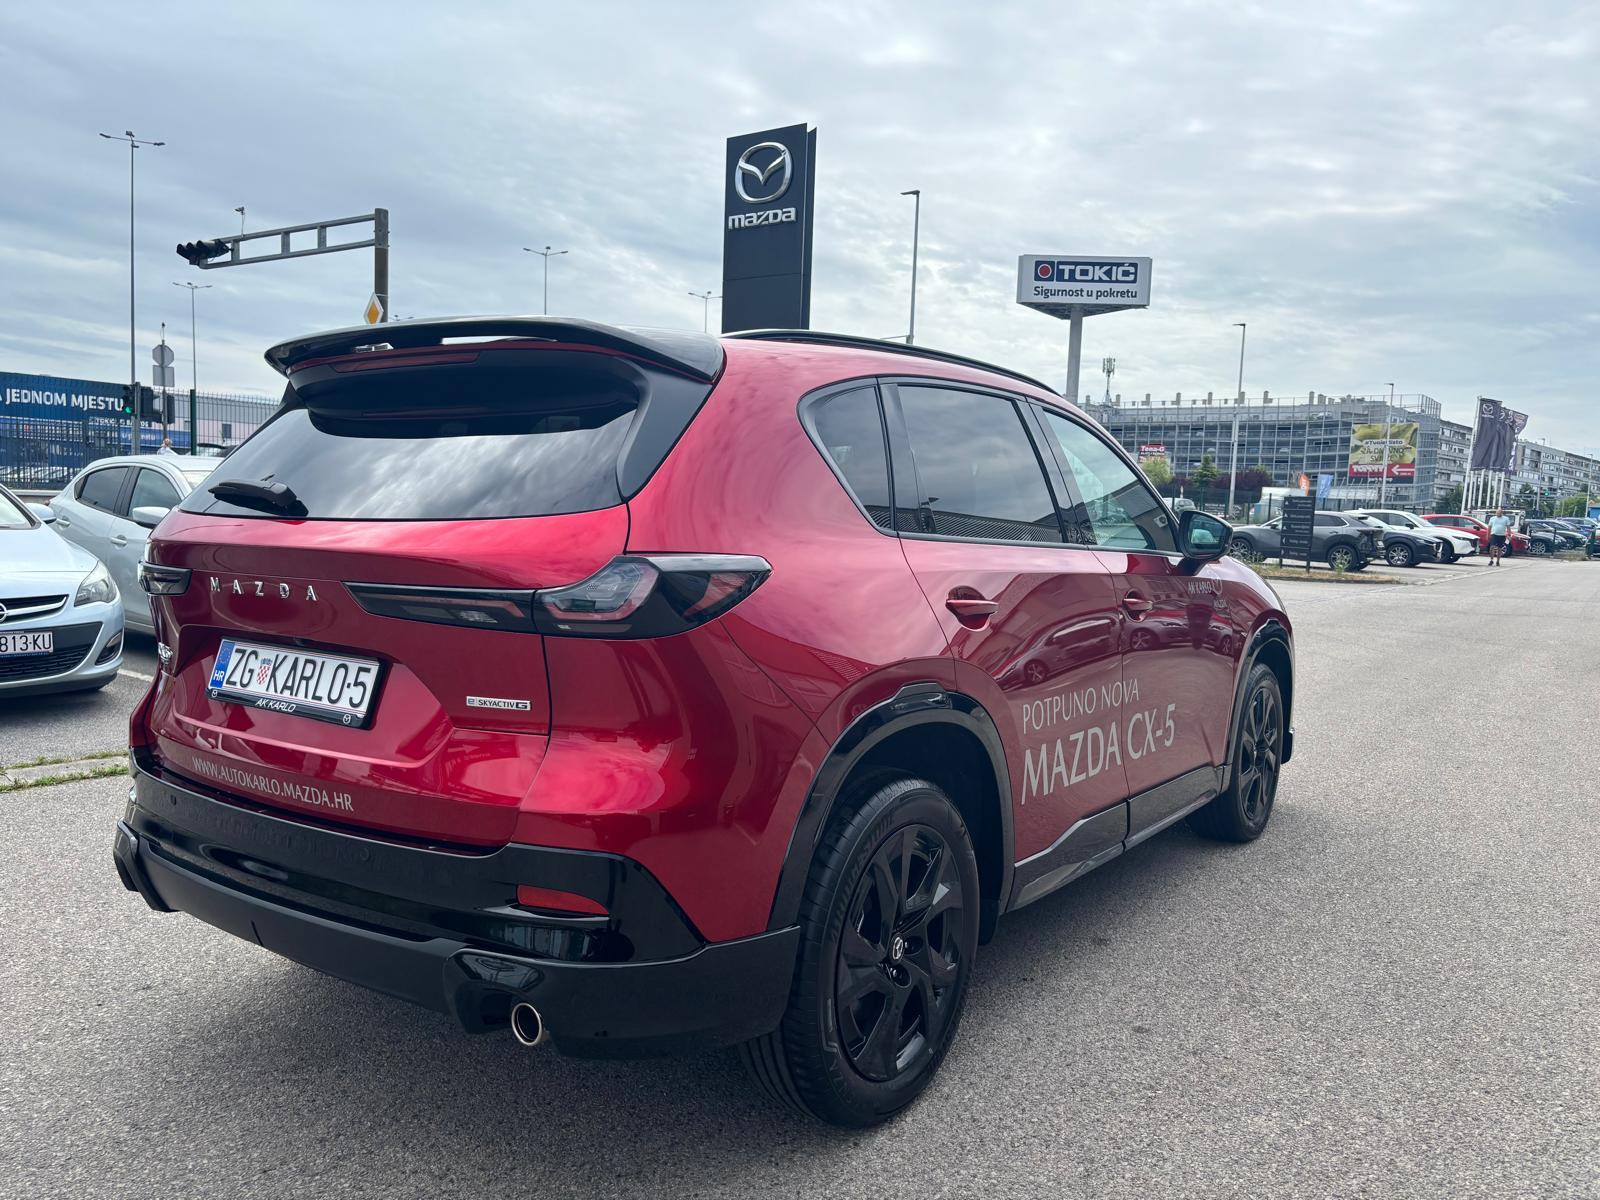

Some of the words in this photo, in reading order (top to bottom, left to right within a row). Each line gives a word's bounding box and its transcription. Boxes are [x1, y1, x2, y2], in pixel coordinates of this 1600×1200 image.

[1058, 263, 1136, 281] TOKIĆ
[1033, 285, 1084, 299] Sigurnost
[1086, 289, 1093, 297] u
[1095, 287, 1137, 300] pokretu
[6, 388, 67, 407] JEDNOM
[71, 393, 124, 411] MJESTU
[210, 576, 318, 602] MAZDA
[214, 670, 225, 682] HR
[225, 648, 259, 688] ZG
[255, 698, 269, 708] AK
[268, 700, 297, 713] KARLO
[1022, 687, 1097, 734] POTPUNO
[1101, 678, 1140, 708] NOVA
[1020, 721, 1122, 805] MAZDA
[1126, 703, 1176, 761] CX-5
[192, 756, 354, 812] WWW.AUTOKARLO.MAZDA.HR
